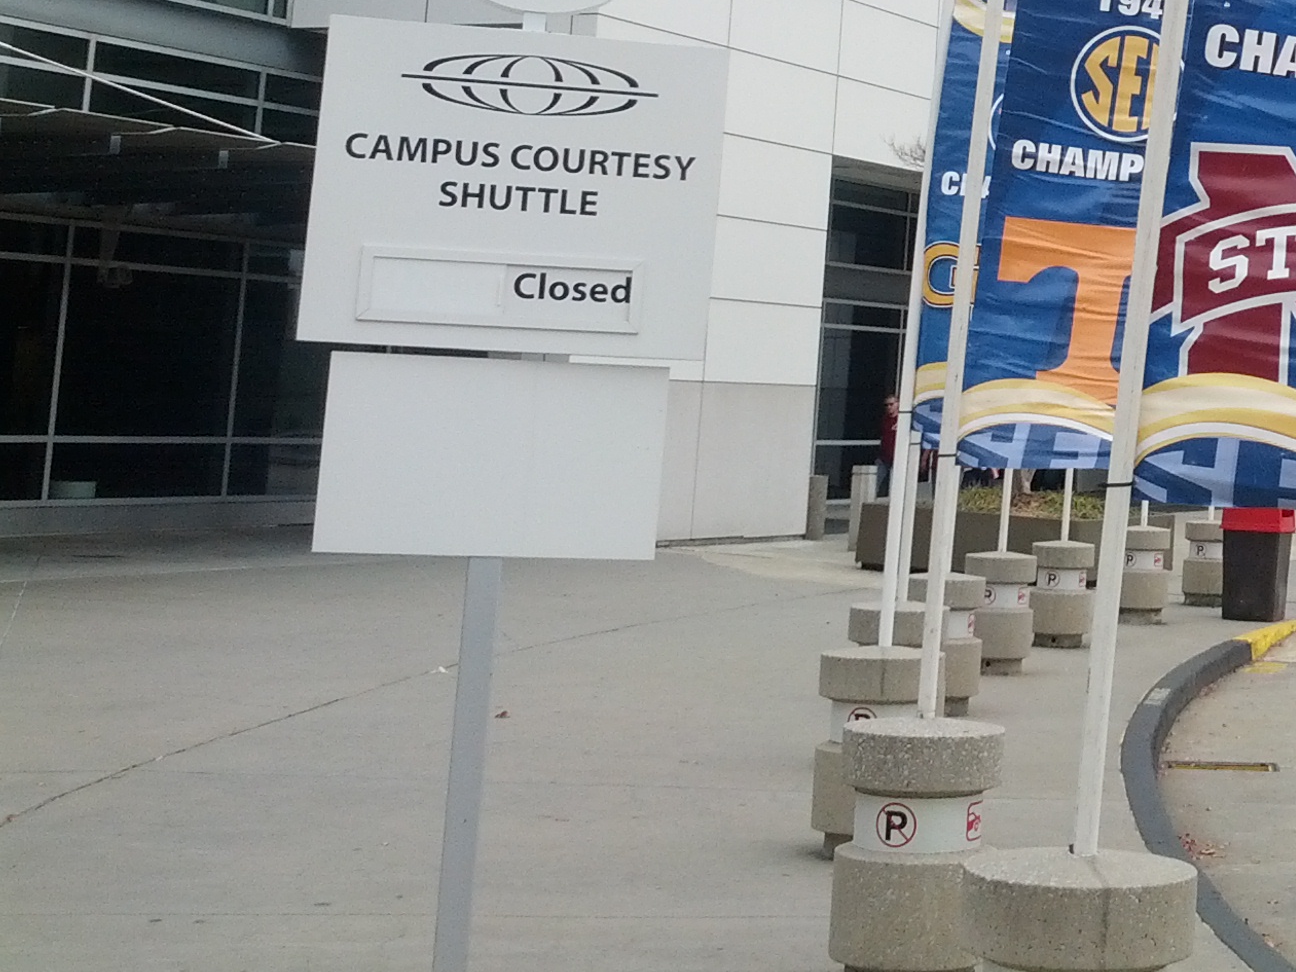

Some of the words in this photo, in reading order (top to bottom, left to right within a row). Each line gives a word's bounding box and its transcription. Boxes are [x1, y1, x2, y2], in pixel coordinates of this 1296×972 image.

[345, 132, 500, 168] CAMPUS
[510, 144, 697, 182] COURTESY
[1011, 138, 1144, 182] CHAMP
[438, 181, 600, 217] SHUTTLE
[512, 272, 633, 305] Closed
